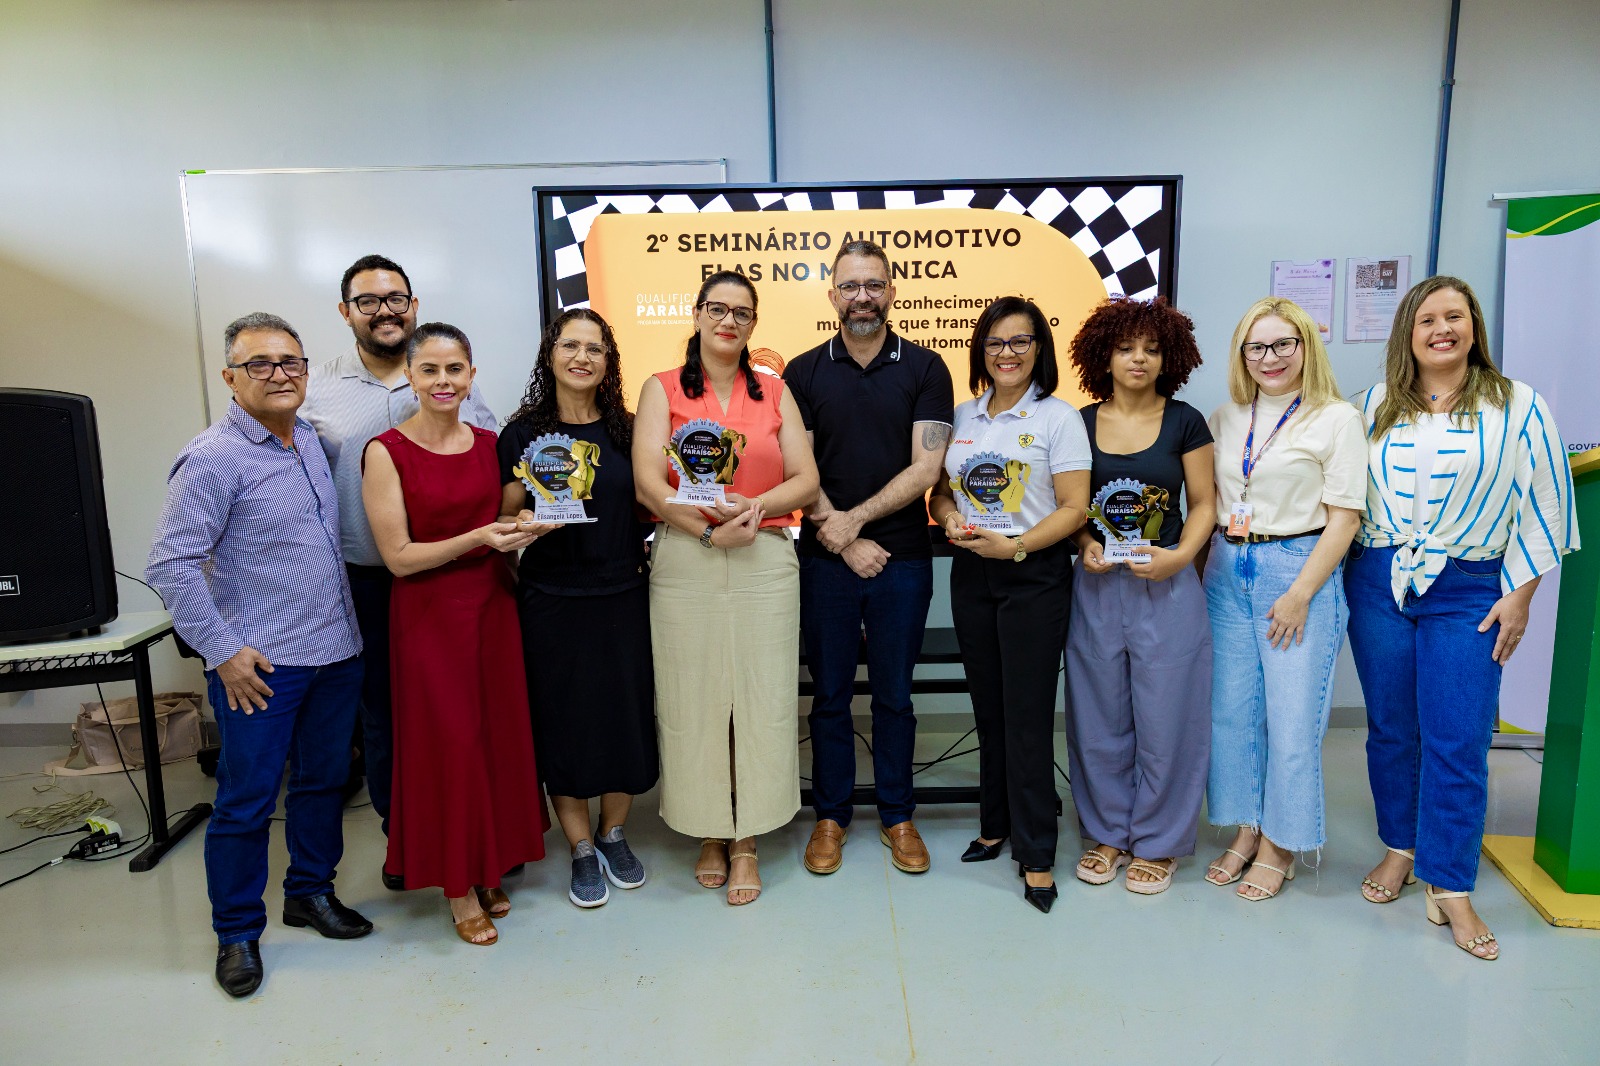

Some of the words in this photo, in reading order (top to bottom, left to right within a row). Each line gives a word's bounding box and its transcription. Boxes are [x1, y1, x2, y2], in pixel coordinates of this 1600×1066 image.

[646, 234, 668, 252] 2º
[678, 226, 831, 252] SEMINÁRIO
[773, 263, 810, 281] NO
[636, 293, 698, 304] QUALIFICA
[636, 302, 692, 317] PARAÍS
[899, 318, 930, 333] que
[535, 464, 564, 472] PARAÍSO
